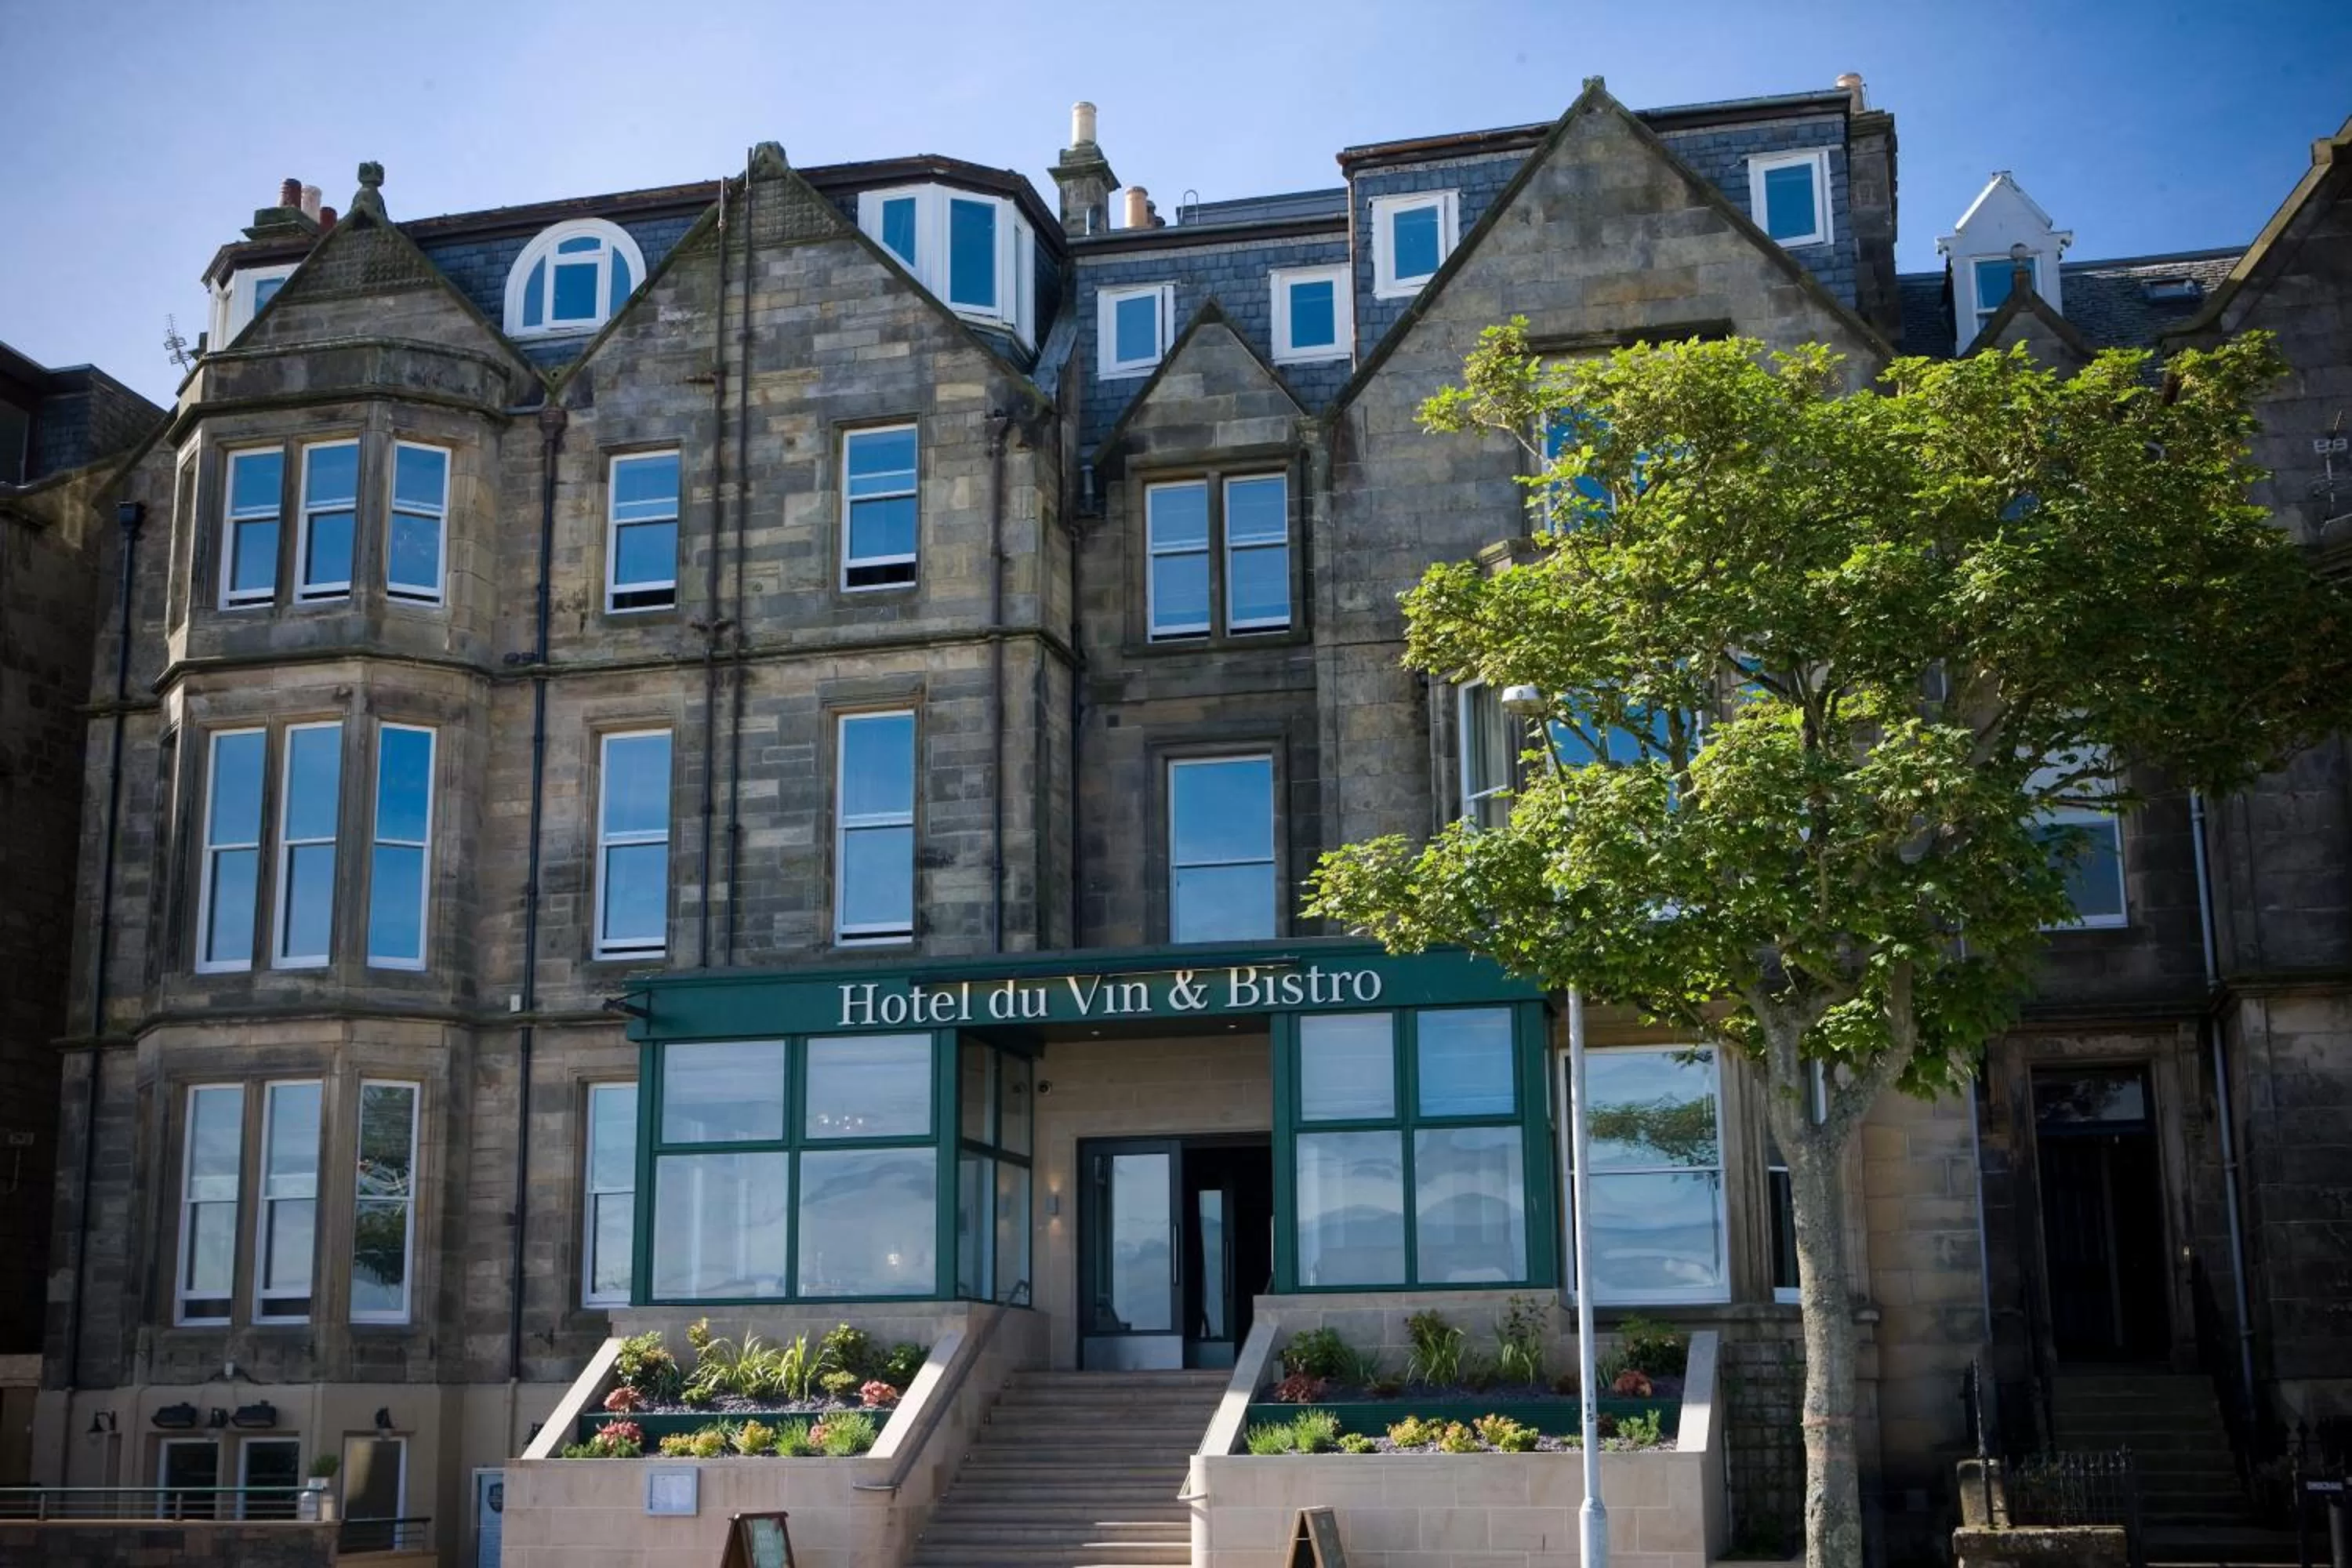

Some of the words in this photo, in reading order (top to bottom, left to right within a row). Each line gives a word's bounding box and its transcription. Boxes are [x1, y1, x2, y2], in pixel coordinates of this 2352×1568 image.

[837, 982, 972, 1025] Hotel
[989, 980, 1048, 1019] du
[1065, 975, 1152, 1016] Vin
[1168, 970, 1208, 1011] &
[1225, 965, 1382, 1007] Bistro
